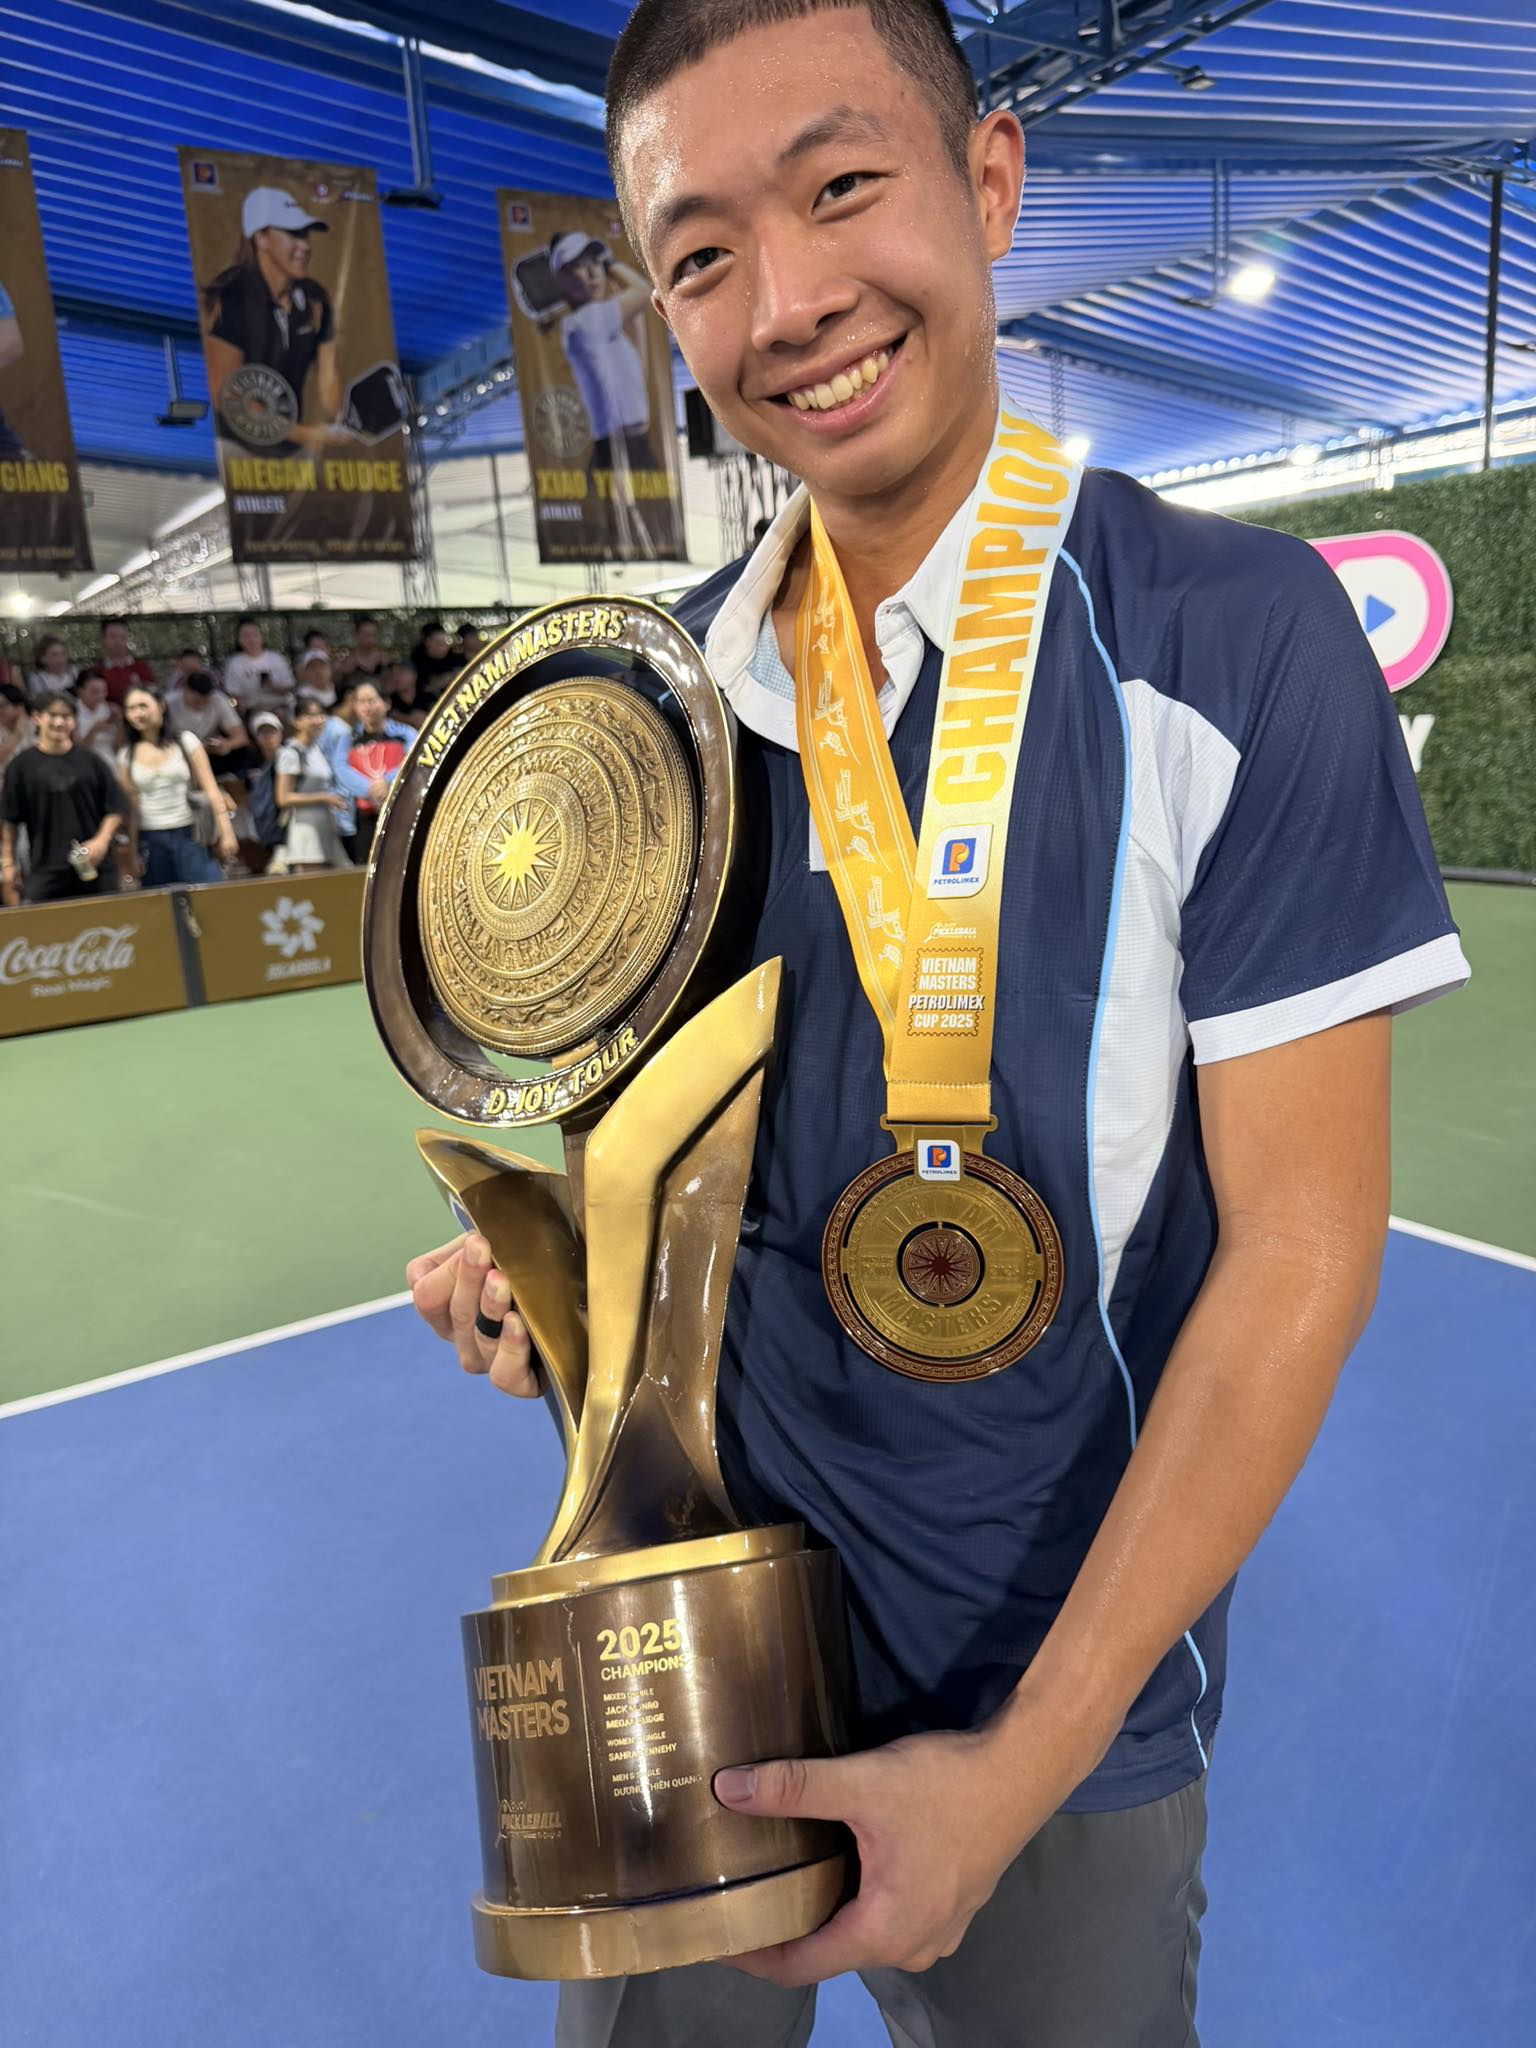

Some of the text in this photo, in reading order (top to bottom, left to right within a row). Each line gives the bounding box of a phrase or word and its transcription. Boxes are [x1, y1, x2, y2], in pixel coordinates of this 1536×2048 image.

[229, 459, 402, 492] MEGAN FUDGE
[933, 408, 1073, 806] CHAMPION
[418, 609, 626, 767] VIETNAM MASTERS
[933, 876, 980, 885] PETROLIMEX
[921, 957, 977, 973] VIETNAM
[919, 975, 977, 990] MASTERS
[908, 994, 985, 1010] PETROLIMEX
[914, 1013, 974, 1028] CUP 2025
[569, 1027, 638, 1096] TOUR
[597, 1618, 681, 1661] 2025
[474, 1657, 565, 1701] VIETNAM
[476, 1699, 571, 1741] MASTERS
[605, 1705, 628, 1716] JACK
